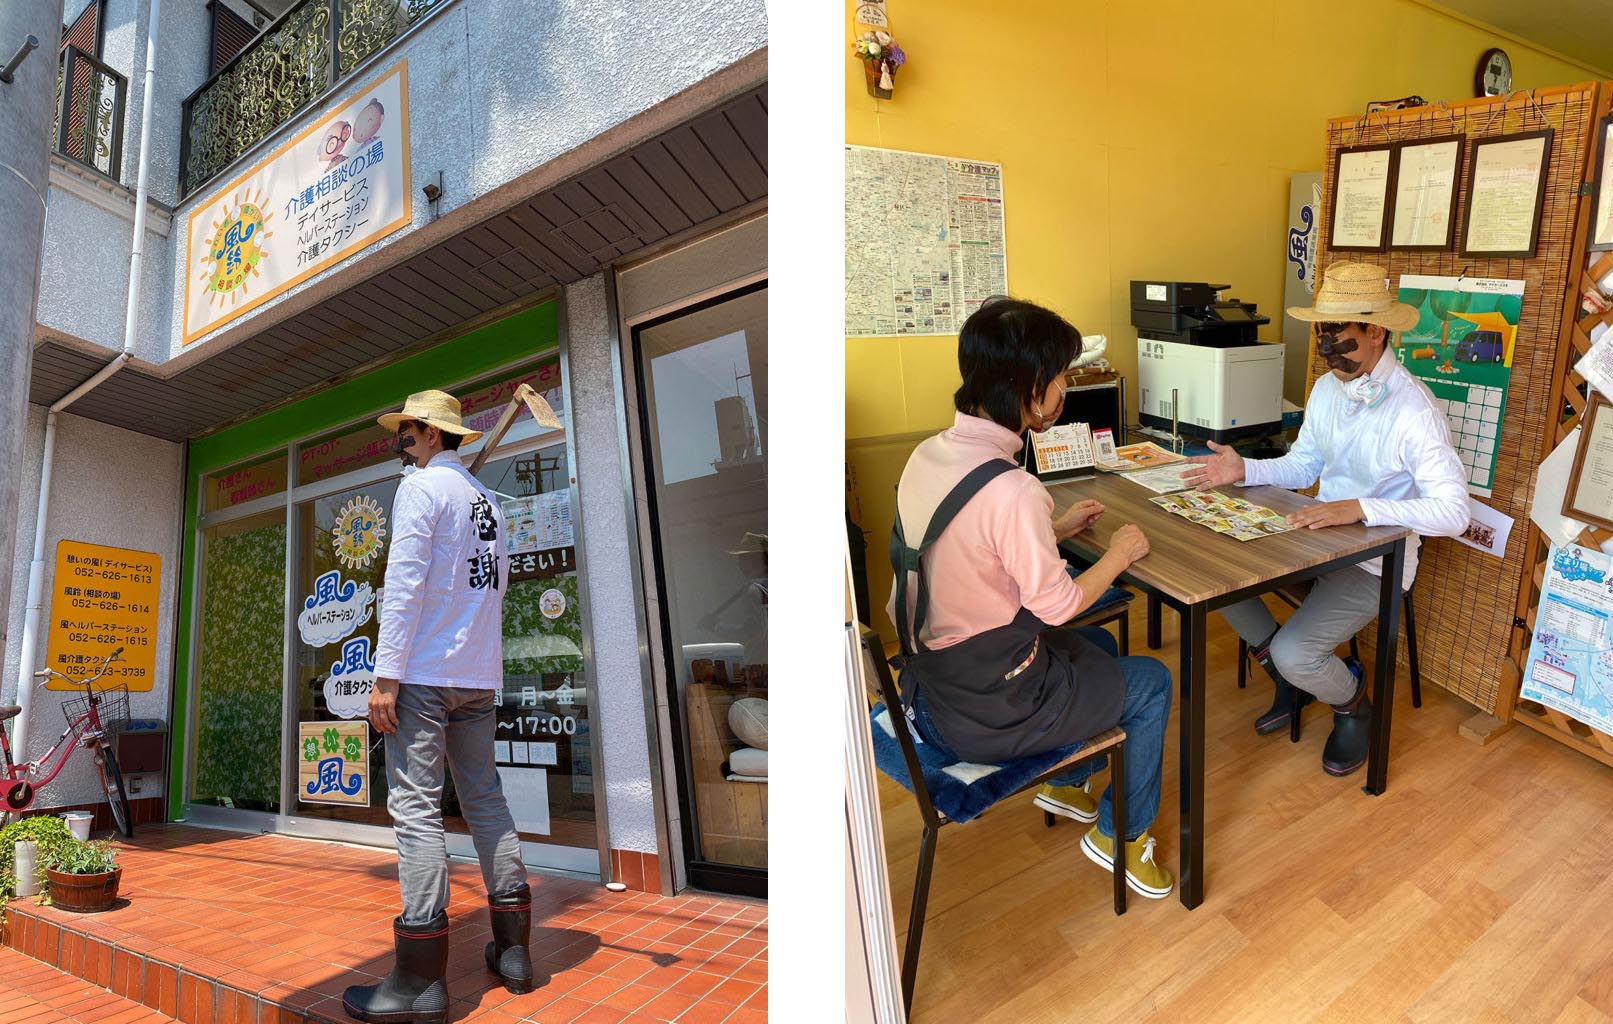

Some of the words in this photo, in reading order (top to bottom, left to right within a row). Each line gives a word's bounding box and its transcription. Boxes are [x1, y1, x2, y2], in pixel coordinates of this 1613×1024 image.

[285, 141, 384, 220] 介護相談の場
[297, 197, 369, 246] ヘルパーステーション
[297, 219, 369, 267] 介護タクシー
[468, 493, 499, 591] 感謝
[74, 567, 152, 584] 052-626-1613
[64, 587, 81, 597] 風鈴
[83, 589, 121, 600] (相談の場)
[306, 571, 355, 609] 風
[71, 599, 150, 614] 052-626-1614
[307, 608, 356, 627] ヘルパーステーション
[60, 620, 148, 634] 風ヘルパーステーション
[68, 633, 148, 646] 052-626-1615
[66, 666, 146, 677] 052-623-3739
[332, 639, 376, 677] 風
[306, 756, 363, 796] 風
